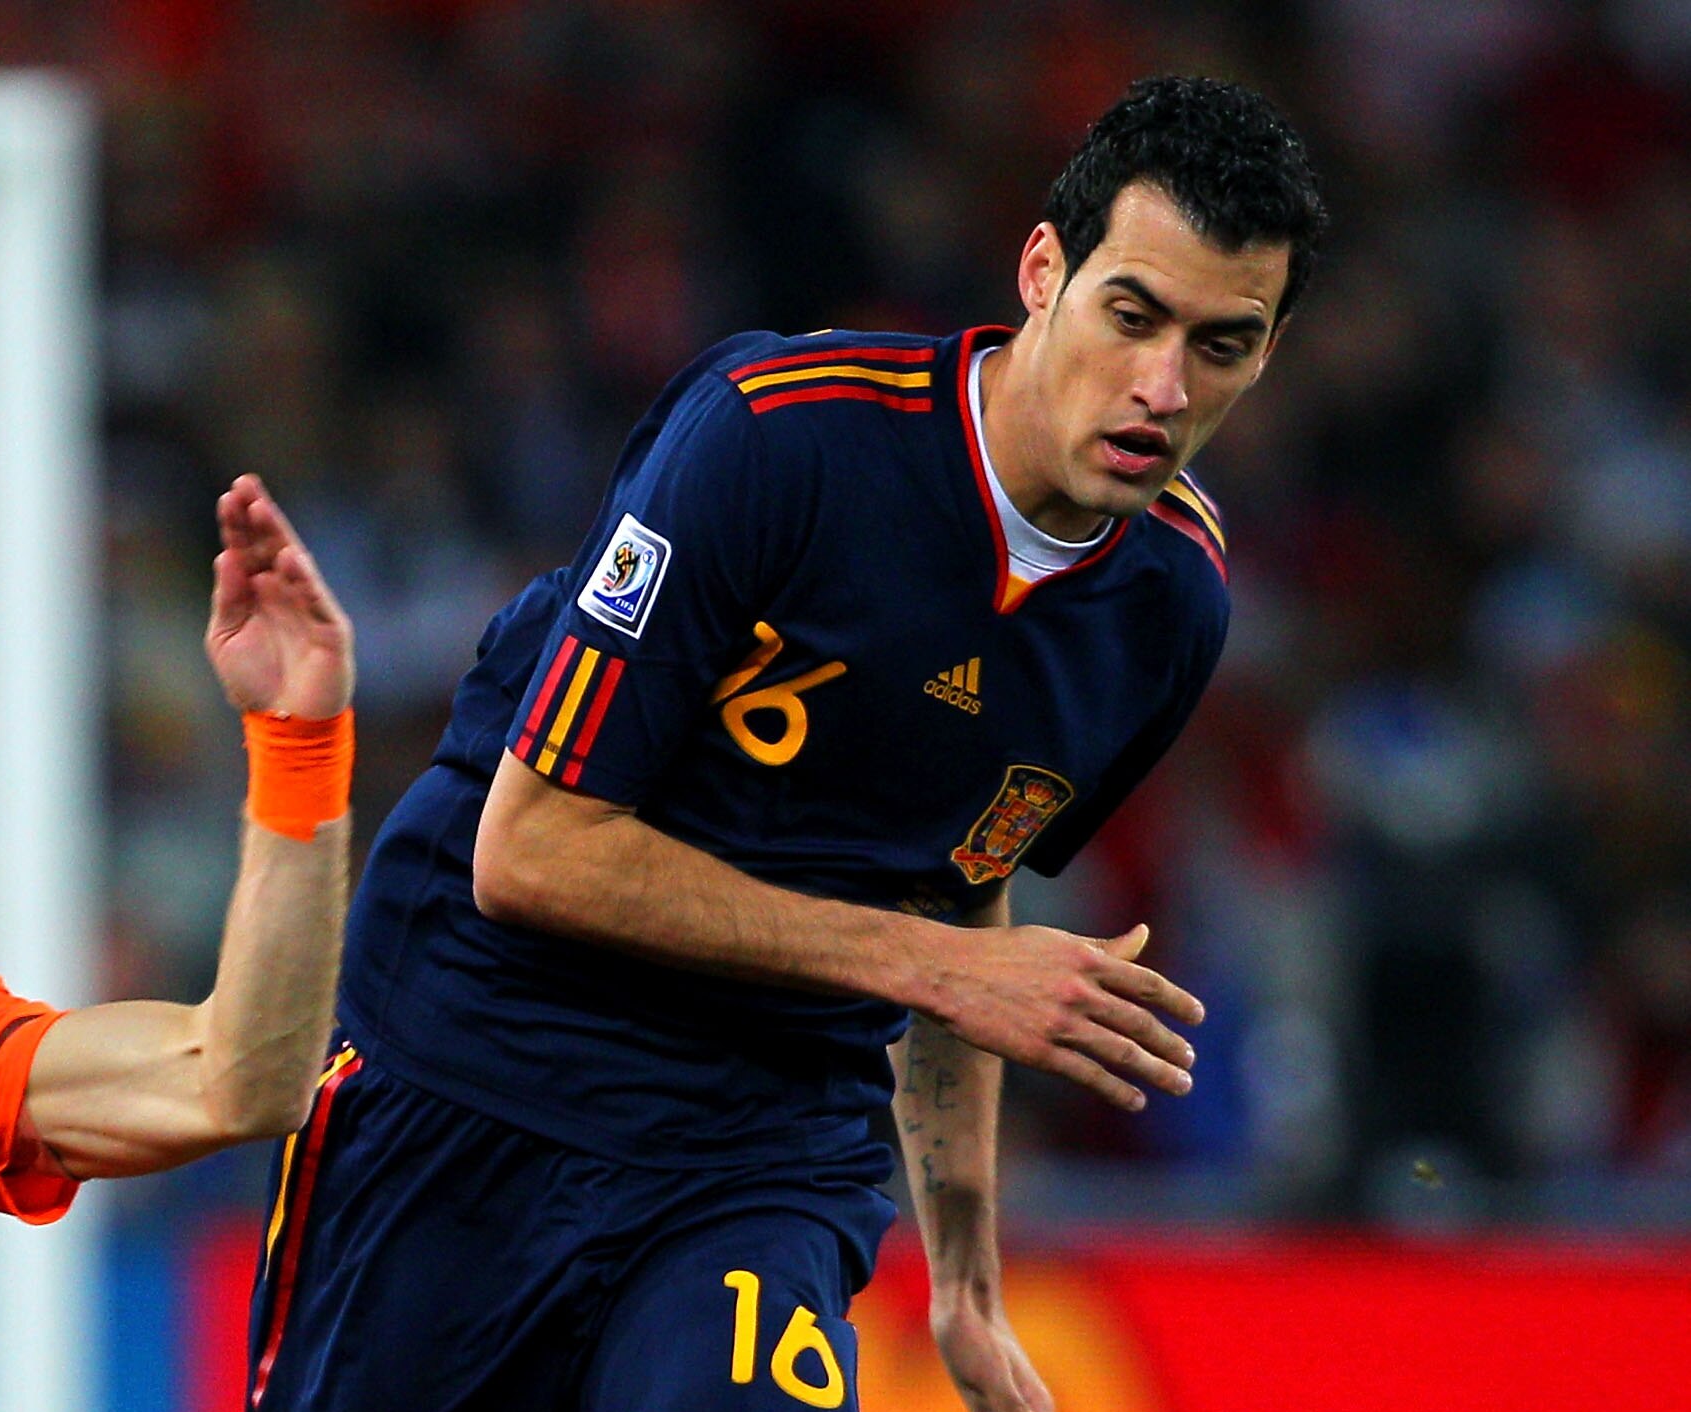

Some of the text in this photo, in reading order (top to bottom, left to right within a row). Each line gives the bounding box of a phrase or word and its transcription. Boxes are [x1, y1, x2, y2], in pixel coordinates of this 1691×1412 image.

[614, 597, 636, 612] FIFA
[711, 620, 848, 767] 16
[922, 679, 982, 715] adidas
[723, 1269, 845, 1410] 16
